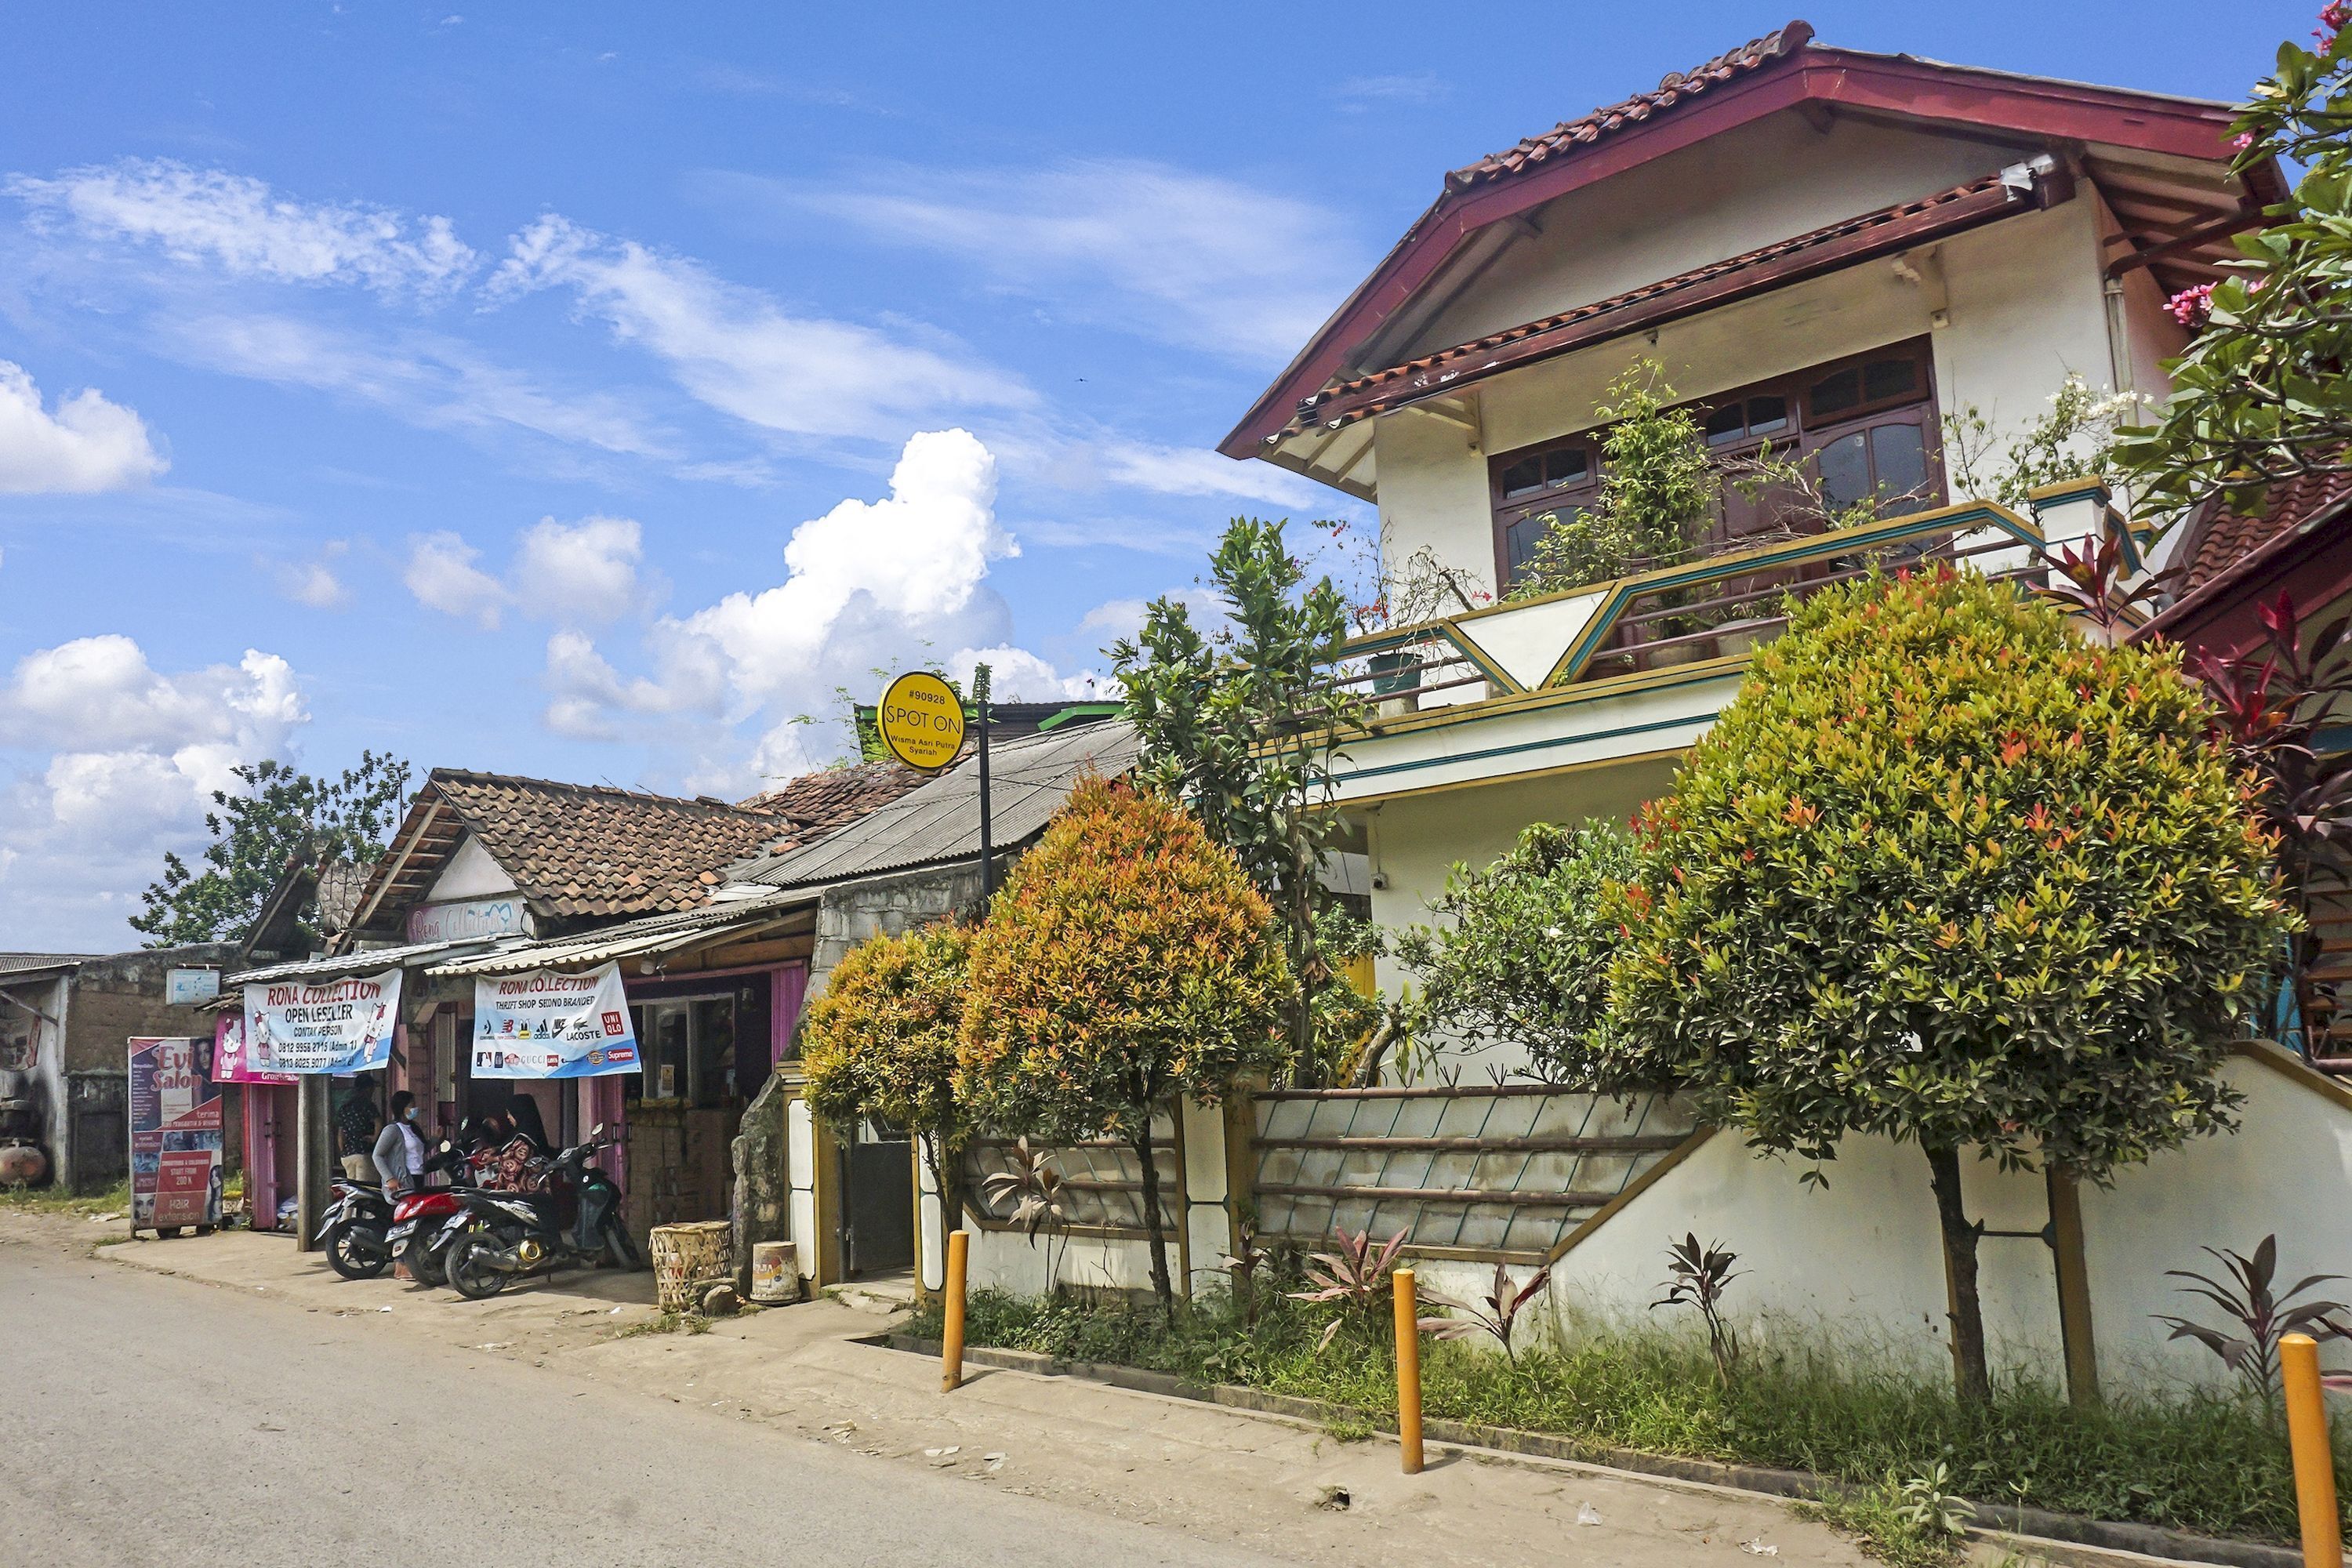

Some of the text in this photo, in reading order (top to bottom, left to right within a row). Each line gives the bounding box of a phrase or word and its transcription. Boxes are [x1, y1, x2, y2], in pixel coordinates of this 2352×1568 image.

[909, 690, 946, 705] #90928
[886, 706, 961, 735] SPOT ON
[891, 735, 916, 745] Wisma
[935, 740, 956, 750] Putra
[909, 746, 938, 756] Syariah
[267, 980, 382, 1006] RONA COLLECTION
[498, 976, 599, 995] RONA COLLECTION
[495, 1000, 517, 1010] THRIFT
[518, 999, 536, 1010] SHOP
[564, 995, 595, 1007] BRANDED
[285, 1007, 310, 1023] OPEN
[603, 1014, 619, 1023] UNI
[293, 1025, 343, 1037] CONTAK PERSON
[566, 1030, 601, 1041] LACOSTE
[606, 1024, 622, 1035] QLO
[151, 1045, 194, 1070] Evi
[521, 1054, 546, 1065] GUCCI
[608, 1051, 633, 1061] Supreme
[151, 1069, 203, 1092] Salon
